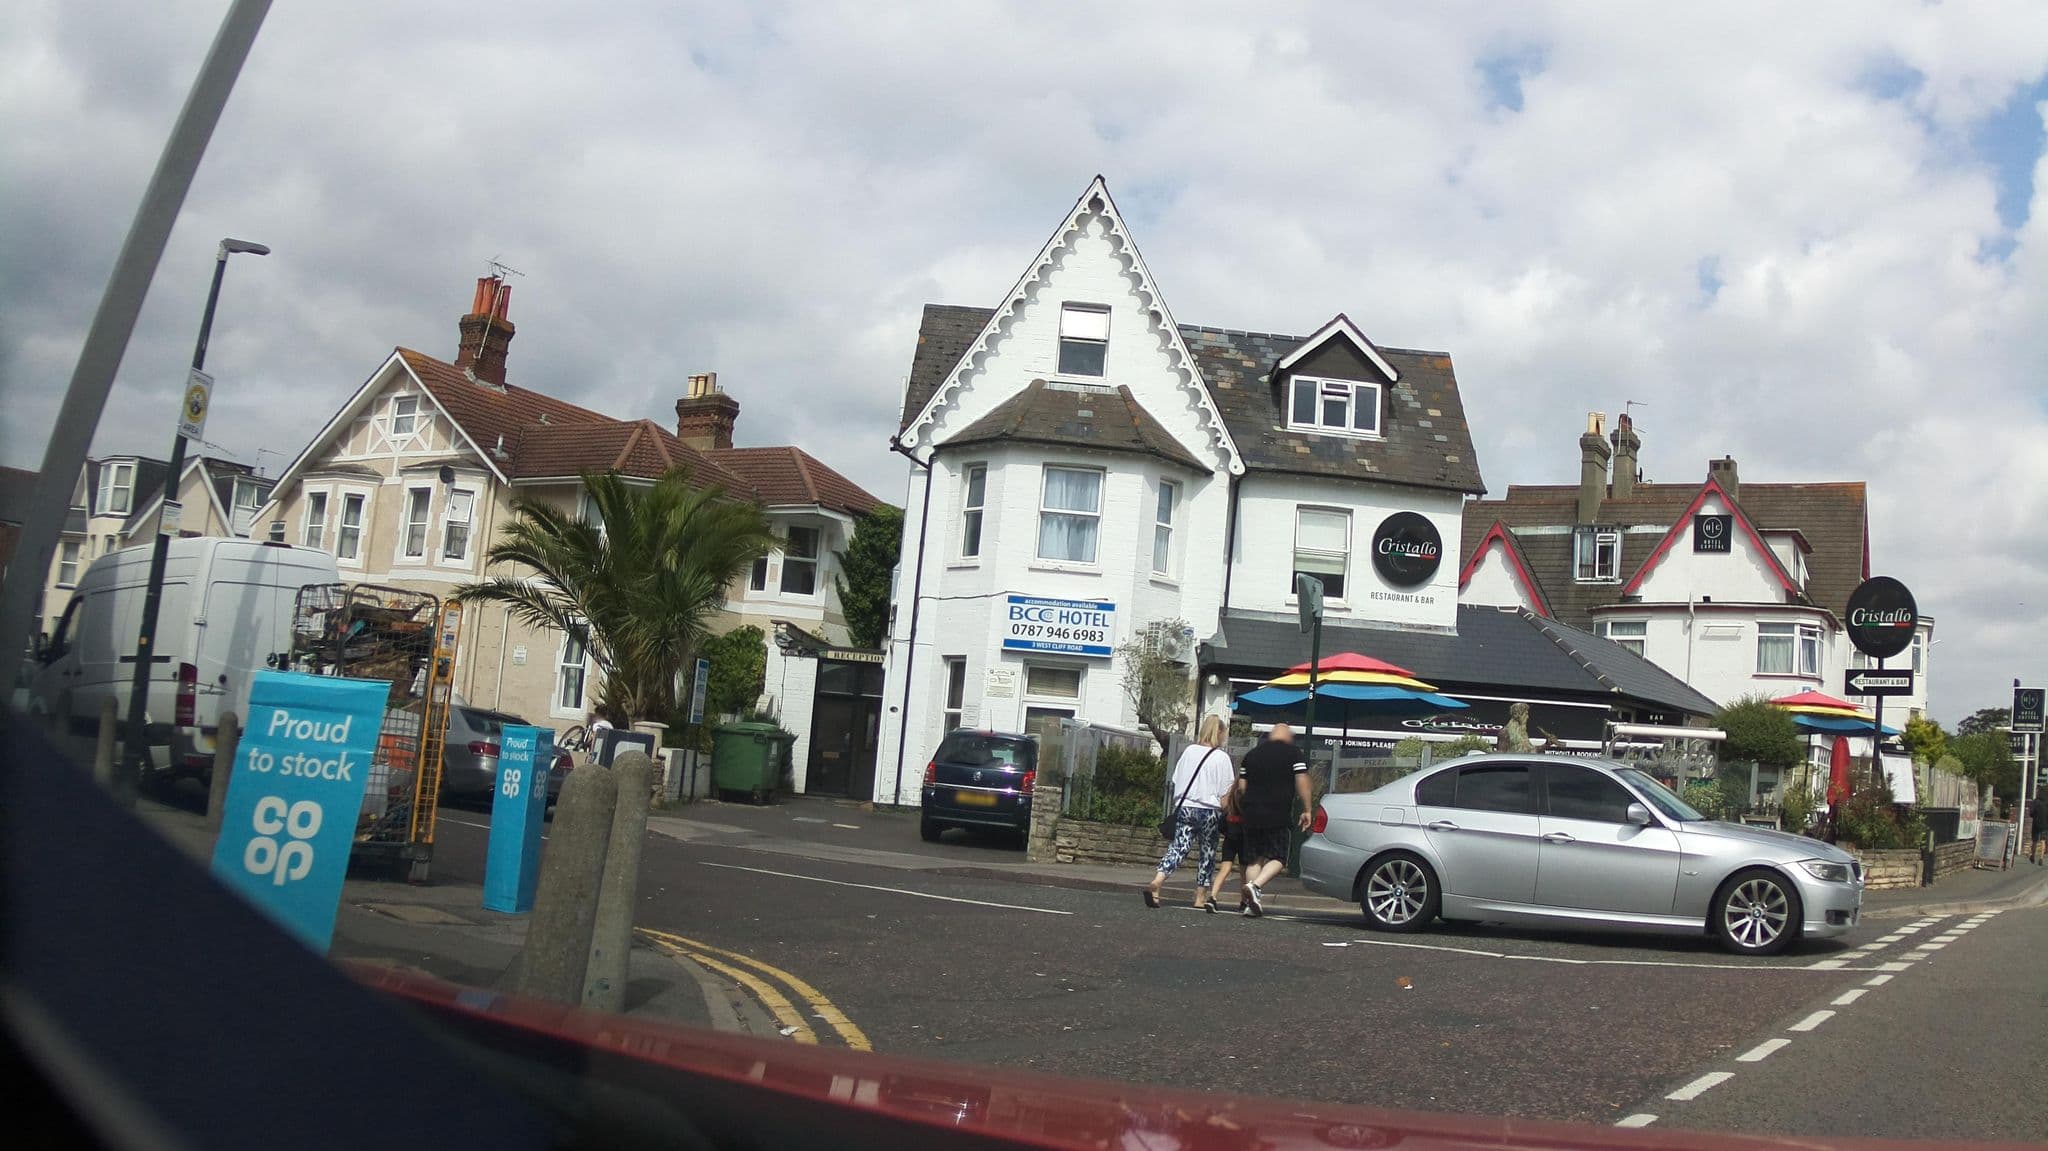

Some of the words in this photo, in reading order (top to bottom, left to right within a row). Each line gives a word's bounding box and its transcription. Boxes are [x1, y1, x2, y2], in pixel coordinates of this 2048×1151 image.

[1379, 537, 1437, 555] Cristallo
[1024, 599, 1071, 608] accommodation
[1370, 591, 1413, 601] RESTAURANT
[1420, 597, 1435, 605] BAR
[1059, 609, 1110, 628] HOTEL
[1851, 607, 1912, 627] Cristallo
[1011, 623, 1044, 637] 0787
[1046, 626, 1071, 640] 946
[1072, 629, 1104, 643] 6983
[1036, 642, 1052, 650] WEST
[833, 651, 886, 663] RECEPTION
[1854, 677, 1890, 686] RESTAURANT
[268, 709, 353, 744] Proud
[1401, 719, 1504, 730] Cristallo
[506, 737, 529, 749] Proud
[502, 751, 509, 760] to
[509, 751, 529, 761] stock
[249, 747, 274, 773] to
[280, 752, 355, 781] stock
